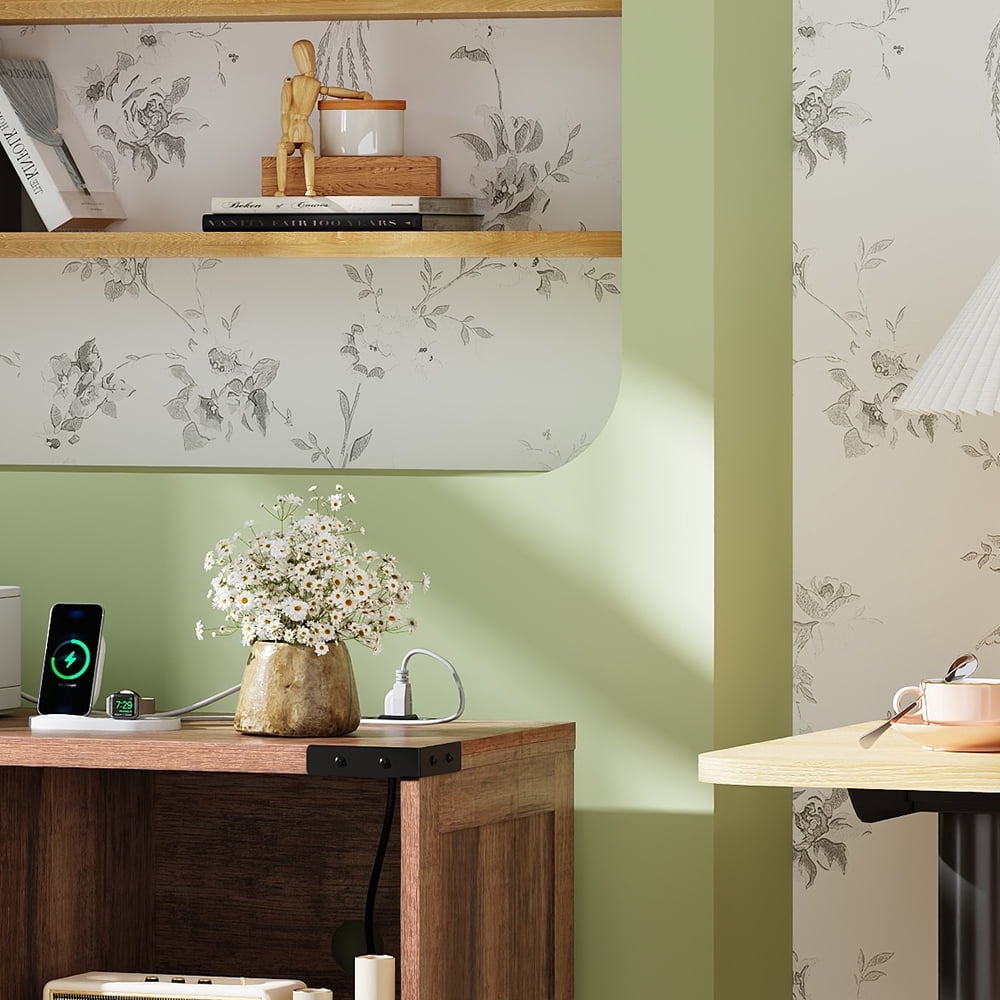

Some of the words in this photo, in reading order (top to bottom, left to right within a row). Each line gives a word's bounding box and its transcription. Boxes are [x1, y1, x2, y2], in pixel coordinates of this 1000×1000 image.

[221, 201, 262, 209] Beken
[272, 219, 307, 227] FAIR
[312, 219, 341, 227] 100
[346, 219, 397, 227] YEARS
[115, 700, 133, 710] 7:29
